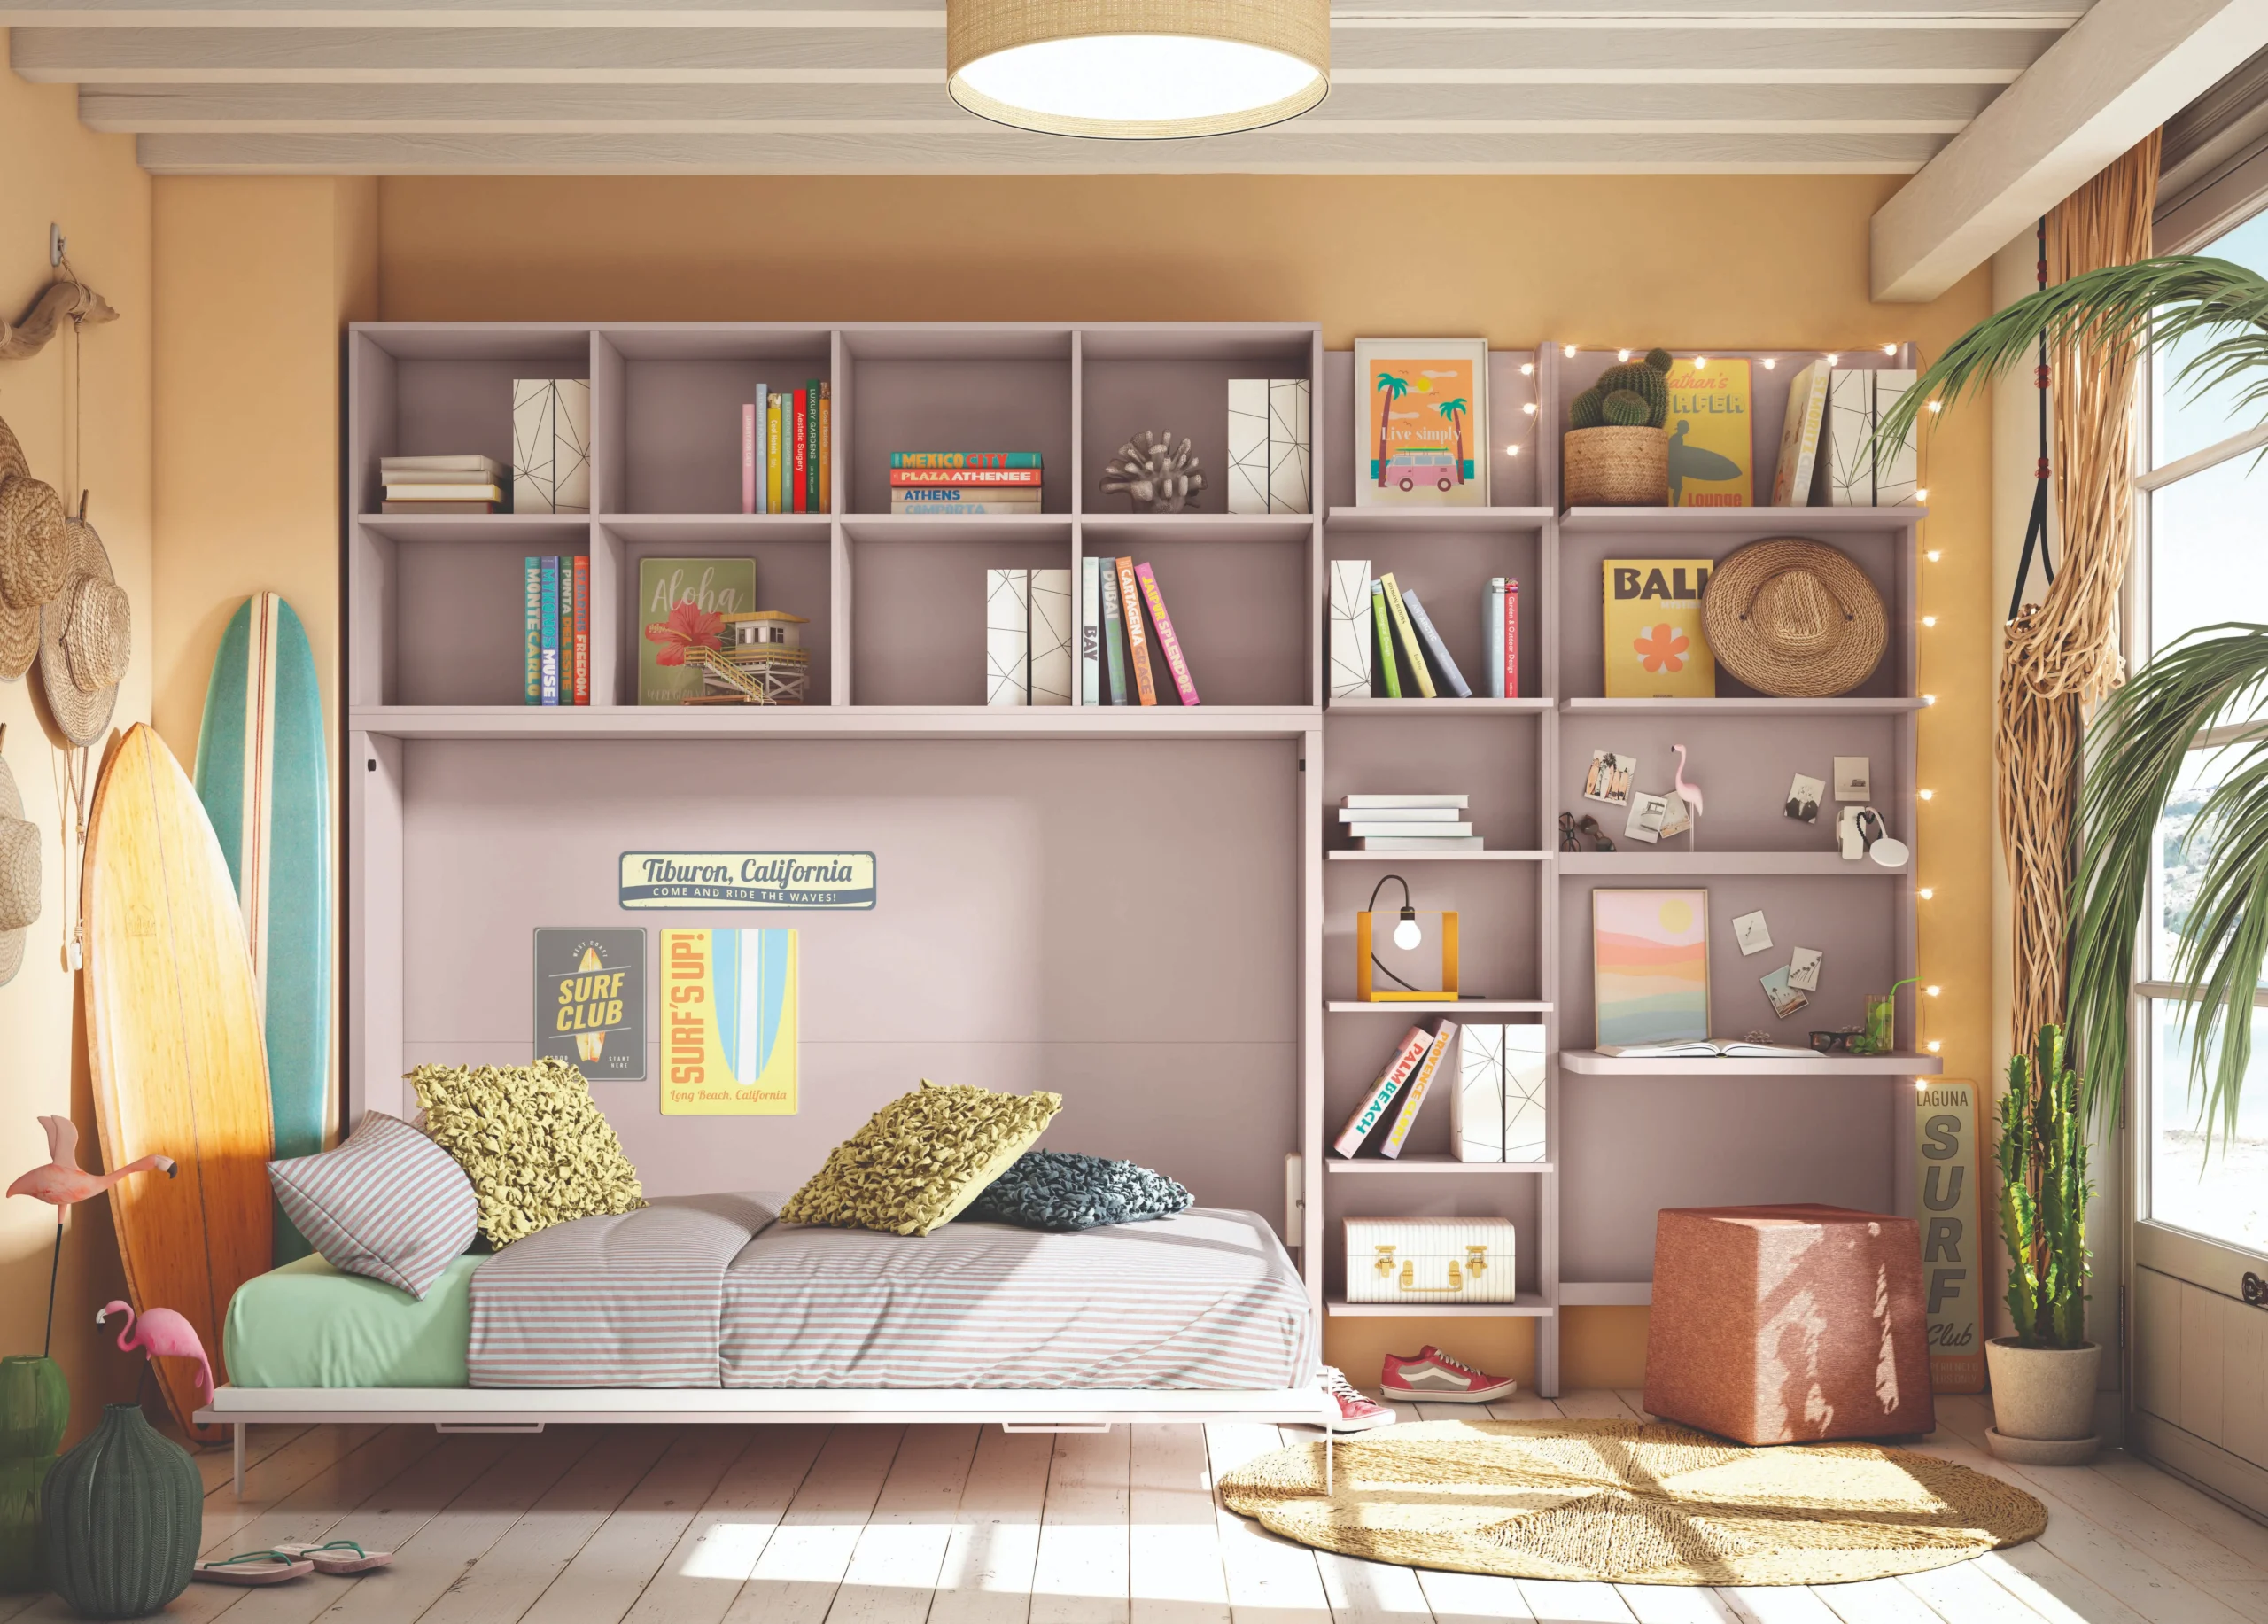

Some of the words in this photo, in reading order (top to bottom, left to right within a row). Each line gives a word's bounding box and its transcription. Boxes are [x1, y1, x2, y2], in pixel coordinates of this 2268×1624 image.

[1672, 392, 1746, 415] RFER
[1381, 426, 1412, 441] Live
[1416, 426, 1462, 446] simply
[796, 443, 804, 472] Surgery
[901, 472, 951, 481] PLAZA
[951, 472, 1031, 481] ATHENEE
[902, 453, 964, 468] MEXICO
[966, 453, 1008, 468] CITY
[904, 490, 961, 501] ATHENS
[1688, 492, 1743, 507] Lounge
[527, 568, 541, 630] MONTE
[562, 569, 572, 615] PUNTA
[650, 567, 744, 614] Aloha
[1102, 570, 1119, 619] DUBAI
[1614, 568, 1708, 600] BALI
[542, 568, 555, 649] MYKONOS
[1410, 603, 1437, 642] ANTARCTIC
[562, 617, 572, 647] DEL
[1084, 626, 1098, 662] BAY
[1121, 569, 1144, 647] CARTAGENA
[1134, 646, 1152, 695] GRACE
[1141, 576, 1166, 622] JAIPUR
[1158, 620, 1192, 695] SPLENDOR
[527, 631, 540, 696] CARLO
[542, 649, 556, 698] MUSE
[562, 649, 572, 691] ESTE
[576, 634, 586, 696] FREEDOM
[642, 859, 734, 886] Tiburon,
[740, 859, 853, 890] California
[652, 887, 688, 897] COME
[694, 888, 720, 897] AND
[726, 889, 755, 899] RIDE
[761, 890, 784, 901] THE
[789, 892, 836, 903] WAVES!
[572, 942, 586, 958] WEST
[589, 940, 608, 958] COAST
[671, 933, 705, 980] UP!
[558, 972, 625, 1005] SURF
[556, 999, 624, 1032] CLUB
[669, 985, 705, 1084] SURF'S
[1390, 1042, 1424, 1085] PALM
[1411, 1031, 1449, 1101] PROVENCE
[670, 1090, 695, 1103] Long
[697, 1090, 732, 1101] Beach,
[735, 1089, 787, 1103] California
[1355, 1081, 1398, 1135] BEACH
[1916, 1090, 1969, 1107] LAGUNA
[1391, 1100, 1417, 1147] GLORY
[1922, 1114, 1967, 1314] SURF
[1927, 1322, 1973, 1347] Club
